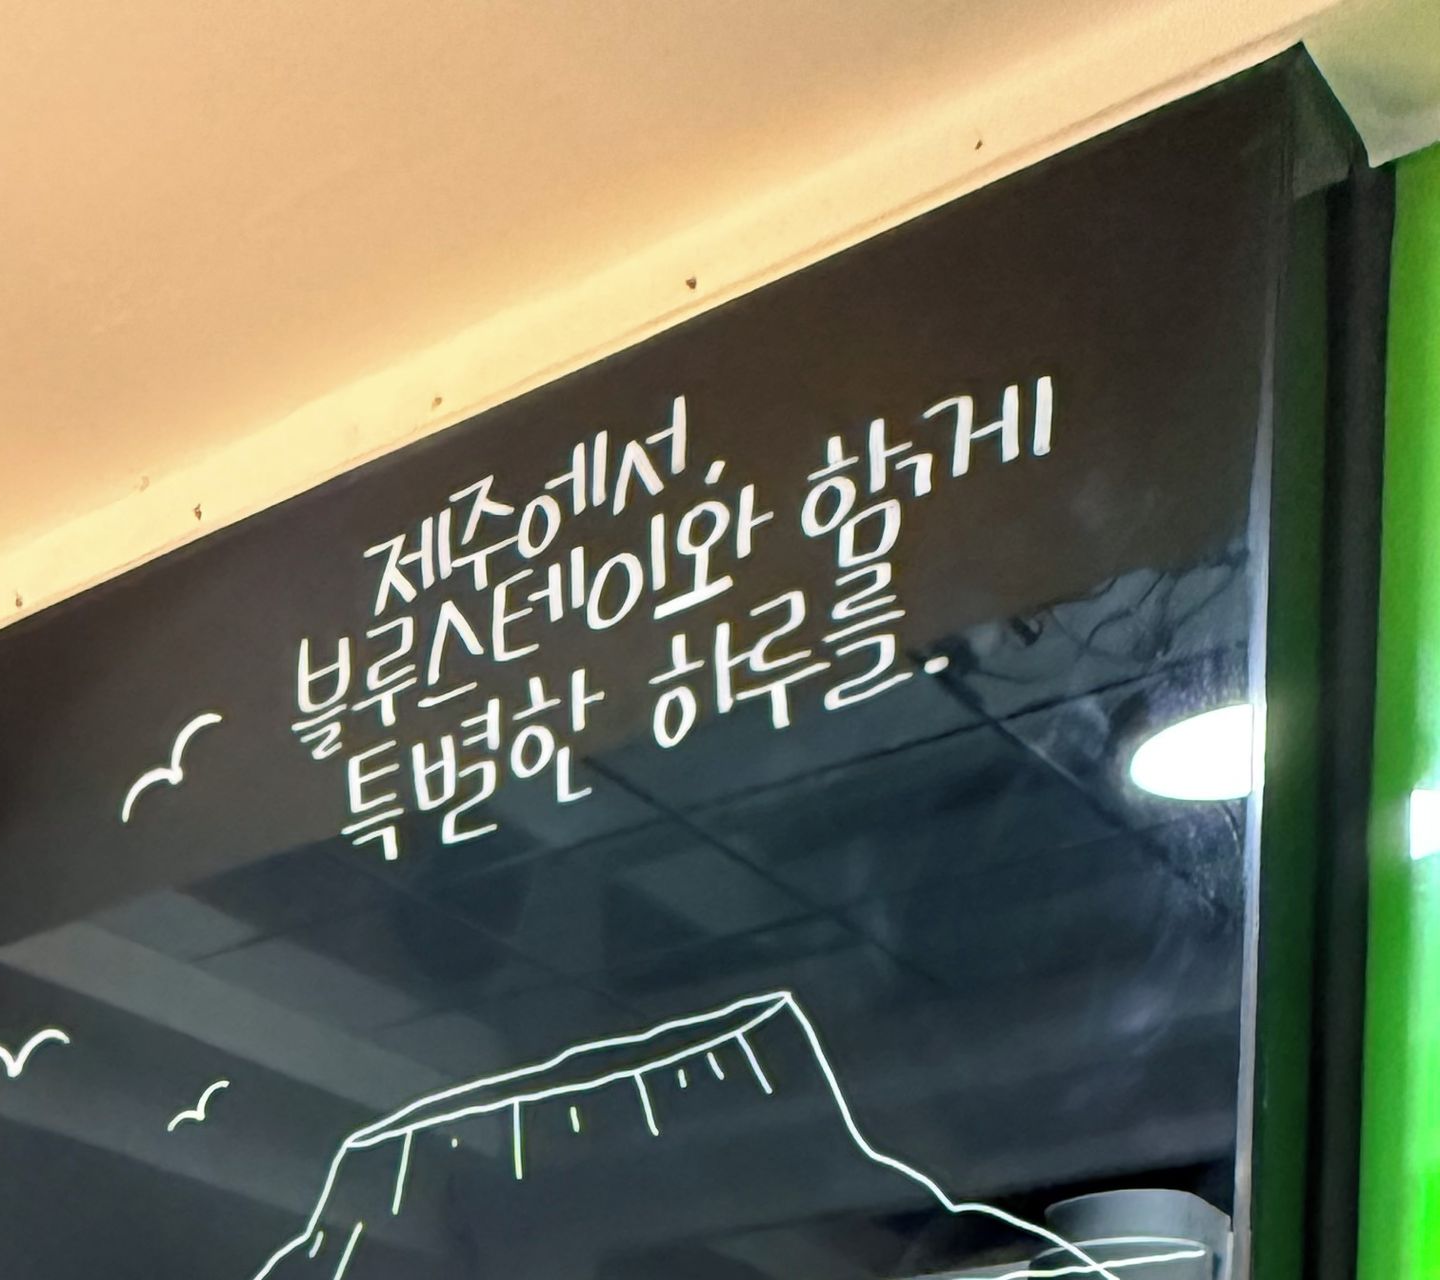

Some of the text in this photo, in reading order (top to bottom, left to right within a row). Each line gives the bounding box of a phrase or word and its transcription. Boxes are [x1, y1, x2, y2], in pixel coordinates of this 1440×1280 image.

[292, 376, 1052, 760] 블루스테이와 함께
[364, 396, 725, 617] 제주에서,
[340, 562, 949, 861] 특별한 하루를.
